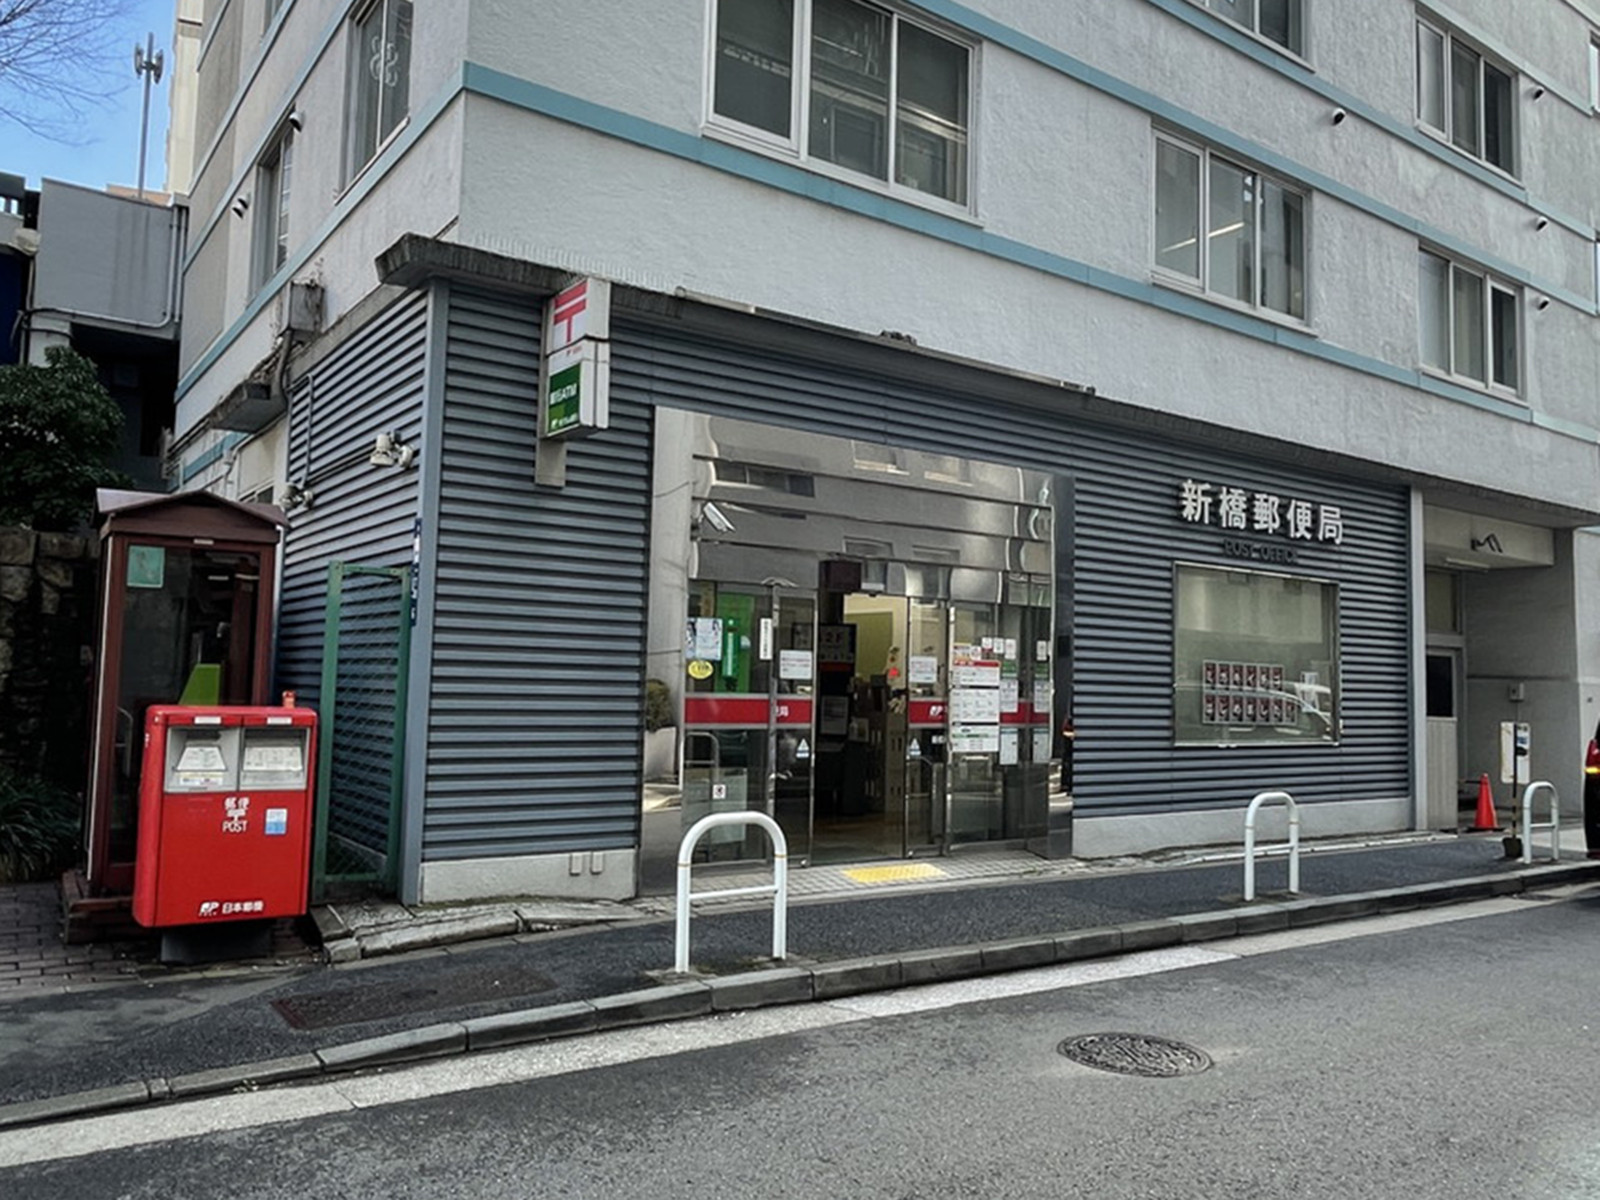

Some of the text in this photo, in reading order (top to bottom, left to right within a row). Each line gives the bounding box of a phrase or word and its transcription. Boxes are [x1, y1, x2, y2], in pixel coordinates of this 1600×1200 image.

[1181, 479, 1344, 545] 新橋郵便局
[1224, 538, 1256, 558] POST
[224, 796, 250, 810] 郵便
[222, 820, 248, 833] POST
